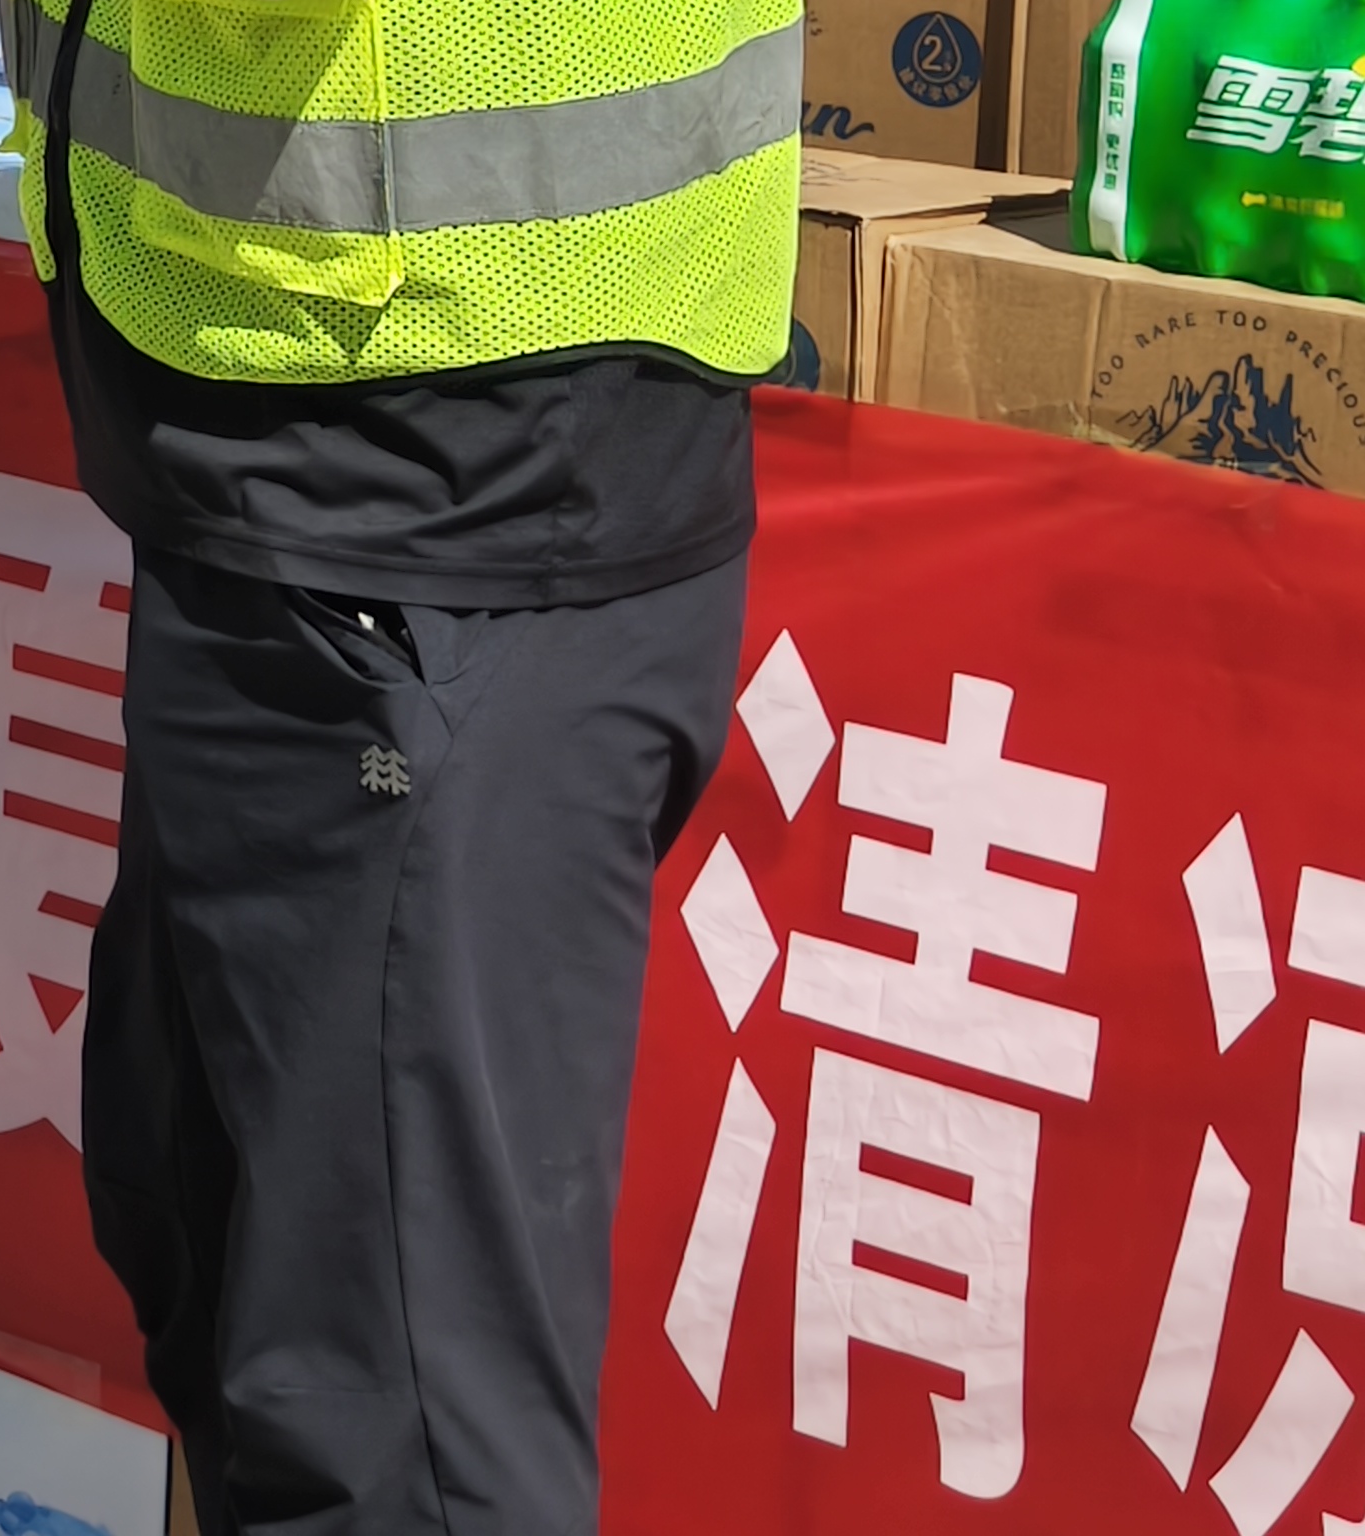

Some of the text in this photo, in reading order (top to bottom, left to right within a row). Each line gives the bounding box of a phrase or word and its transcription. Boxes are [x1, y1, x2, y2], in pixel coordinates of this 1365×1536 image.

[1090, 354, 1125, 400] TOO
[1135, 312, 1197, 349] RARE
[1216, 310, 1267, 332] TOO
